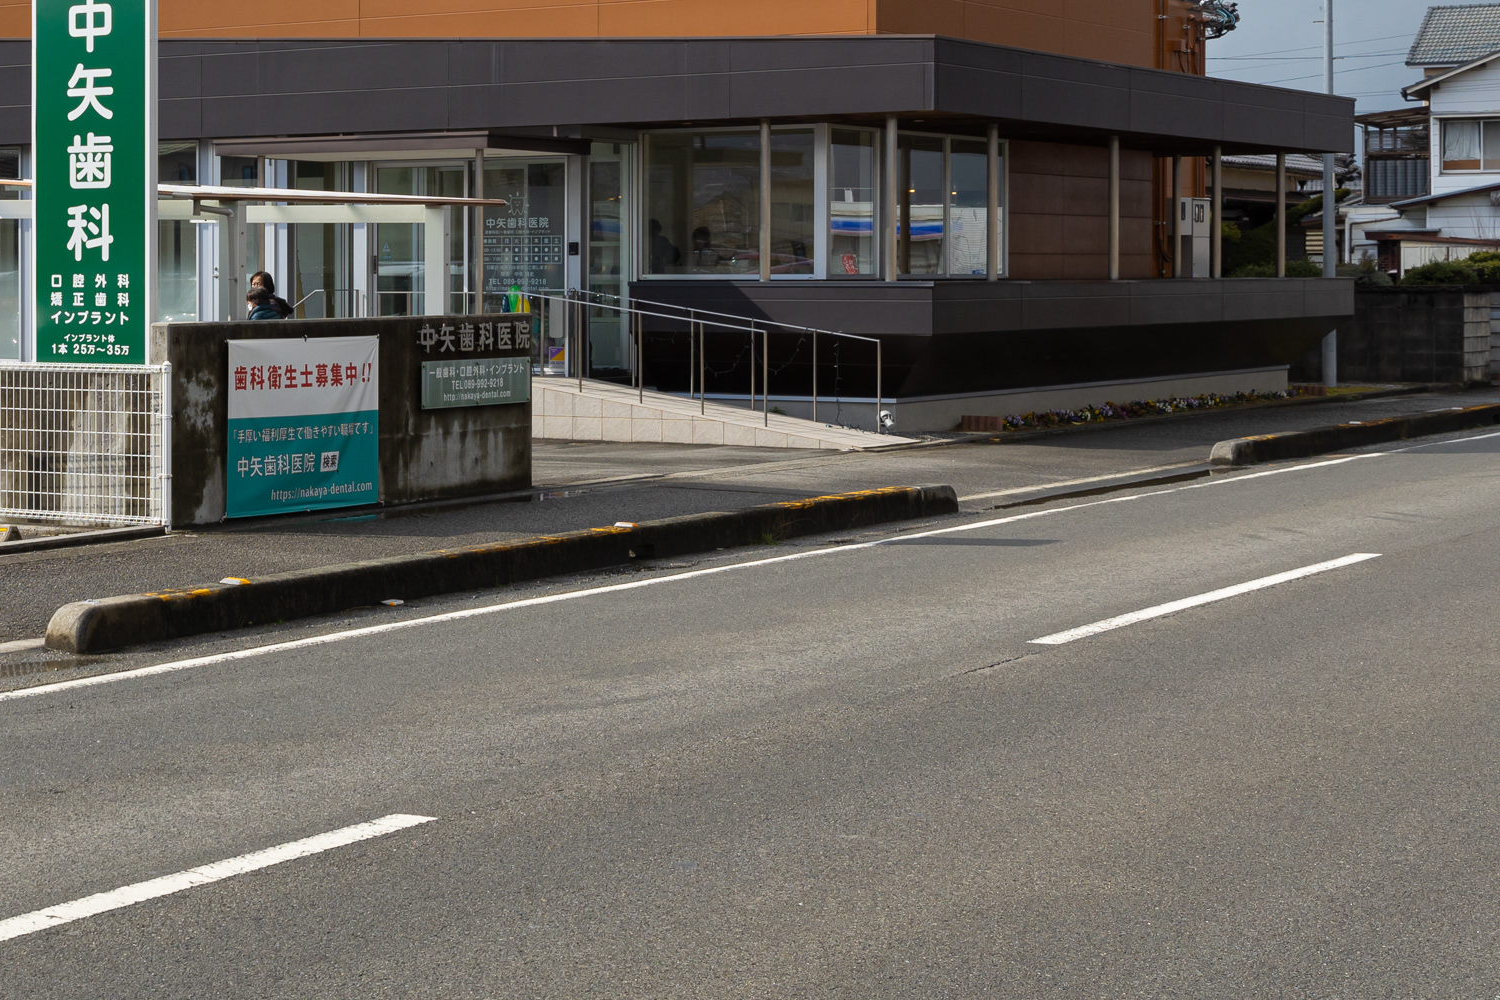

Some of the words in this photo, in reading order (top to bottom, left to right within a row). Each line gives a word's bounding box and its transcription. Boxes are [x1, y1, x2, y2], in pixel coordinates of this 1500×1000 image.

[485, 217, 550, 229] 中矢歯科医院
[51, 273, 129, 288] 口腔外科
[50, 291, 129, 307] 矯正歯科
[51, 310, 129, 325] インプラント
[63, 333, 115, 343] インプラント体
[419, 321, 531, 353] 中矢歯科医院
[51, 343, 68, 355] 1本
[237, 452, 316, 478] 中矢歯科医院
[322, 454, 337, 469] 検索
[270, 481, 373, 503] https://nakaya-dental.com
